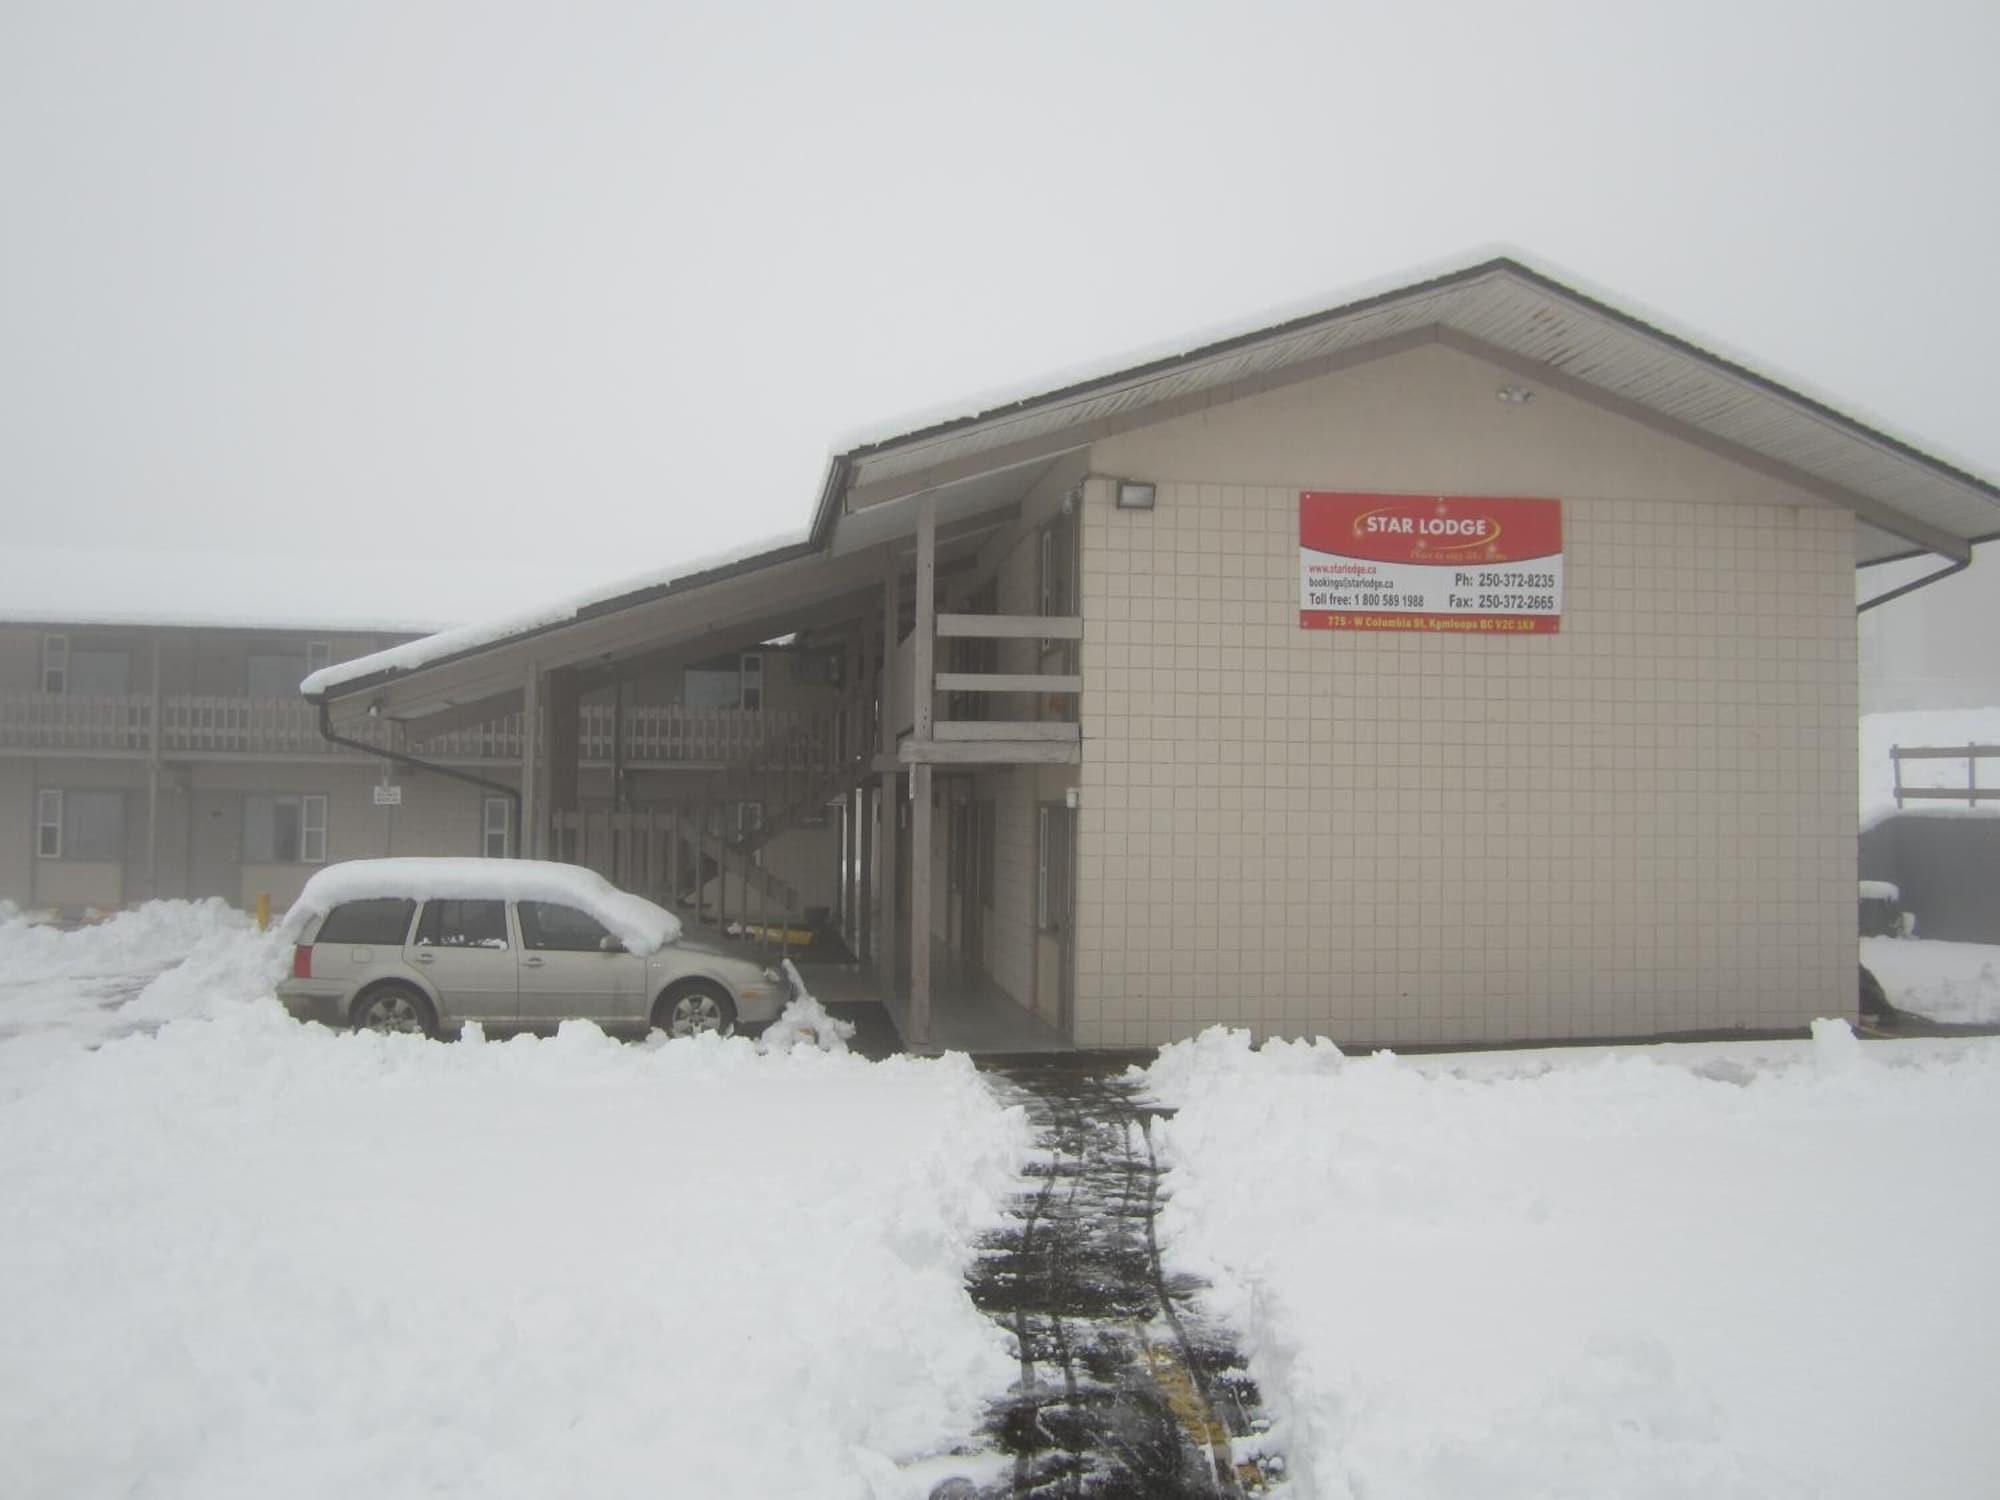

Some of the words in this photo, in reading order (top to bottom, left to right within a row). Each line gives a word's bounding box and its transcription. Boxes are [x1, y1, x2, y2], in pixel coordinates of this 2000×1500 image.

[1367, 516, 1414, 533] STAR
[1419, 518, 1487, 536] LODGE
[1308, 563, 1377, 576] www.starlodge.ca
[1455, 572, 1473, 587] Ph:
[1478, 573, 1556, 588] 250-372-8235
[1309, 592, 1328, 606] Toll
[1329, 592, 1353, 606] free:
[1354, 593, 1360, 606] 1
[1362, 593, 1380, 606] 800
[1402, 594, 1425, 608] 1988
[1449, 594, 1473, 608] Fax:
[1478, 594, 1555, 610] 250-372-2665
[1354, 616, 1364, 627] W
[1365, 616, 1413, 629] Columbia
